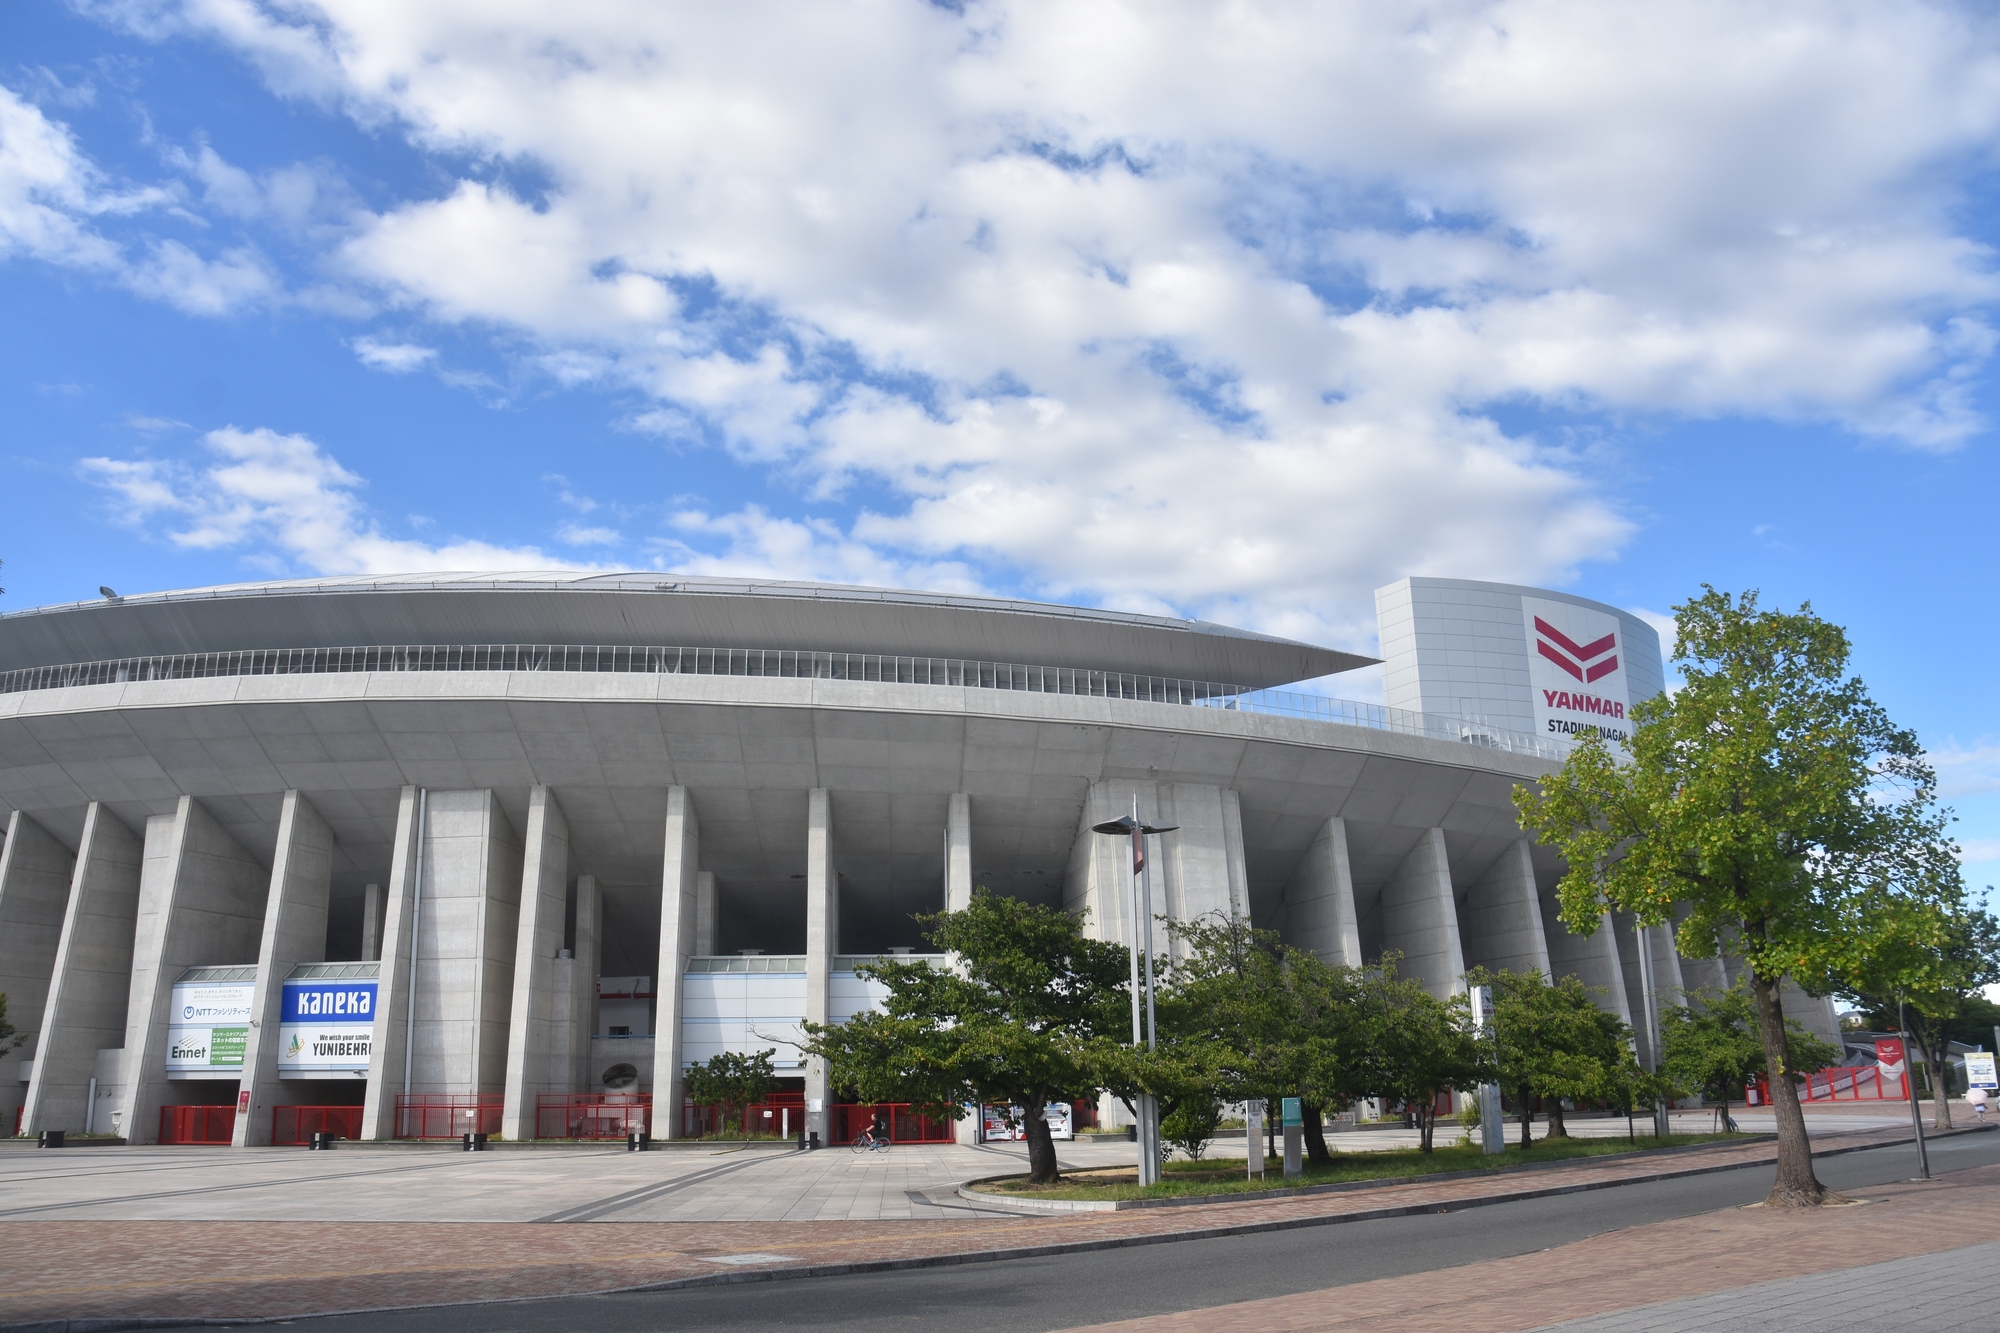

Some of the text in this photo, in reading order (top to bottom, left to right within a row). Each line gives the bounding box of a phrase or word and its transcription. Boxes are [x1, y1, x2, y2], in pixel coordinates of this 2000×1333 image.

[1543, 689, 1624, 719] YANMAR
[1548, 719, 1597, 736] STADIU
[342, 1034, 354, 1042] your
[171, 1046, 206, 1059] Ennet
